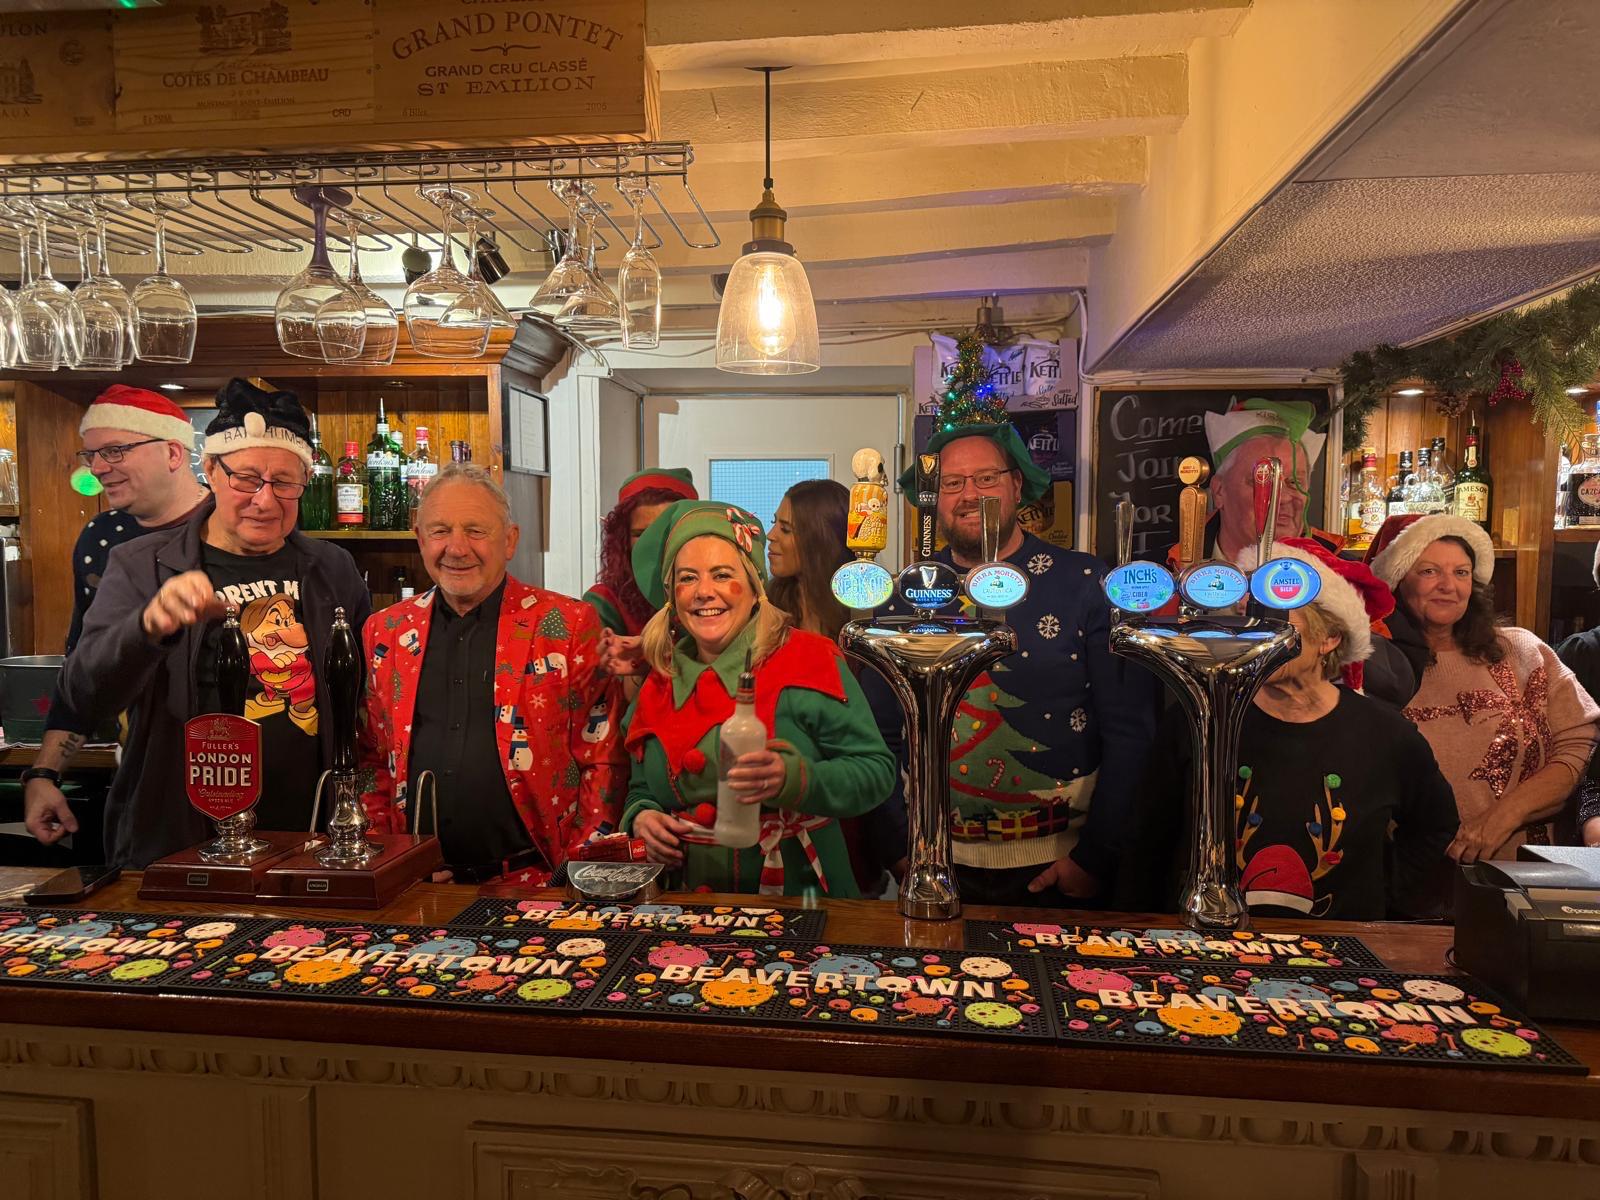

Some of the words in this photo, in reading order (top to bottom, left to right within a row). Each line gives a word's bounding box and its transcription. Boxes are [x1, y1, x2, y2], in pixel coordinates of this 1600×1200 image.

[391, 11, 496, 60] GRAND
[504, 10, 625, 52] PONTET
[217, 72, 237, 87] DE
[241, 67, 330, 86] CHAMBEAU
[424, 64, 484, 77] GRAND
[488, 62, 523, 75] CRU
[528, 57, 588, 73] CLASSÉ
[416, 81, 449, 97] ST
[466, 75, 596, 95] EMILION
[1051, 392, 1078, 407] Salted
[1110, 394, 1204, 442] Come
[224, 427, 247, 444] BA
[264, 426, 304, 449] HUMB
[1456, 485, 1488, 495] JAMESON
[921, 514, 932, 557] GUINNESS
[1123, 568, 1157, 584] INCH'S
[905, 587, 954, 599] GUINNESS
[202, 741, 240, 750] FULLER'S
[189, 751, 252, 764] LONDON
[189, 765, 252, 787] PRIDE
[522, 909, 760, 928] BEAVERTOWN
[0, 932, 191, 957] ERTOWN
[1035, 932, 1304, 957] BEAVERTOWN
[259, 945, 575, 976] BEAVERTOWN
[659, 964, 996, 999] BEAVERTOWN
[1098, 989, 1479, 1025] BEAVERTOWN
